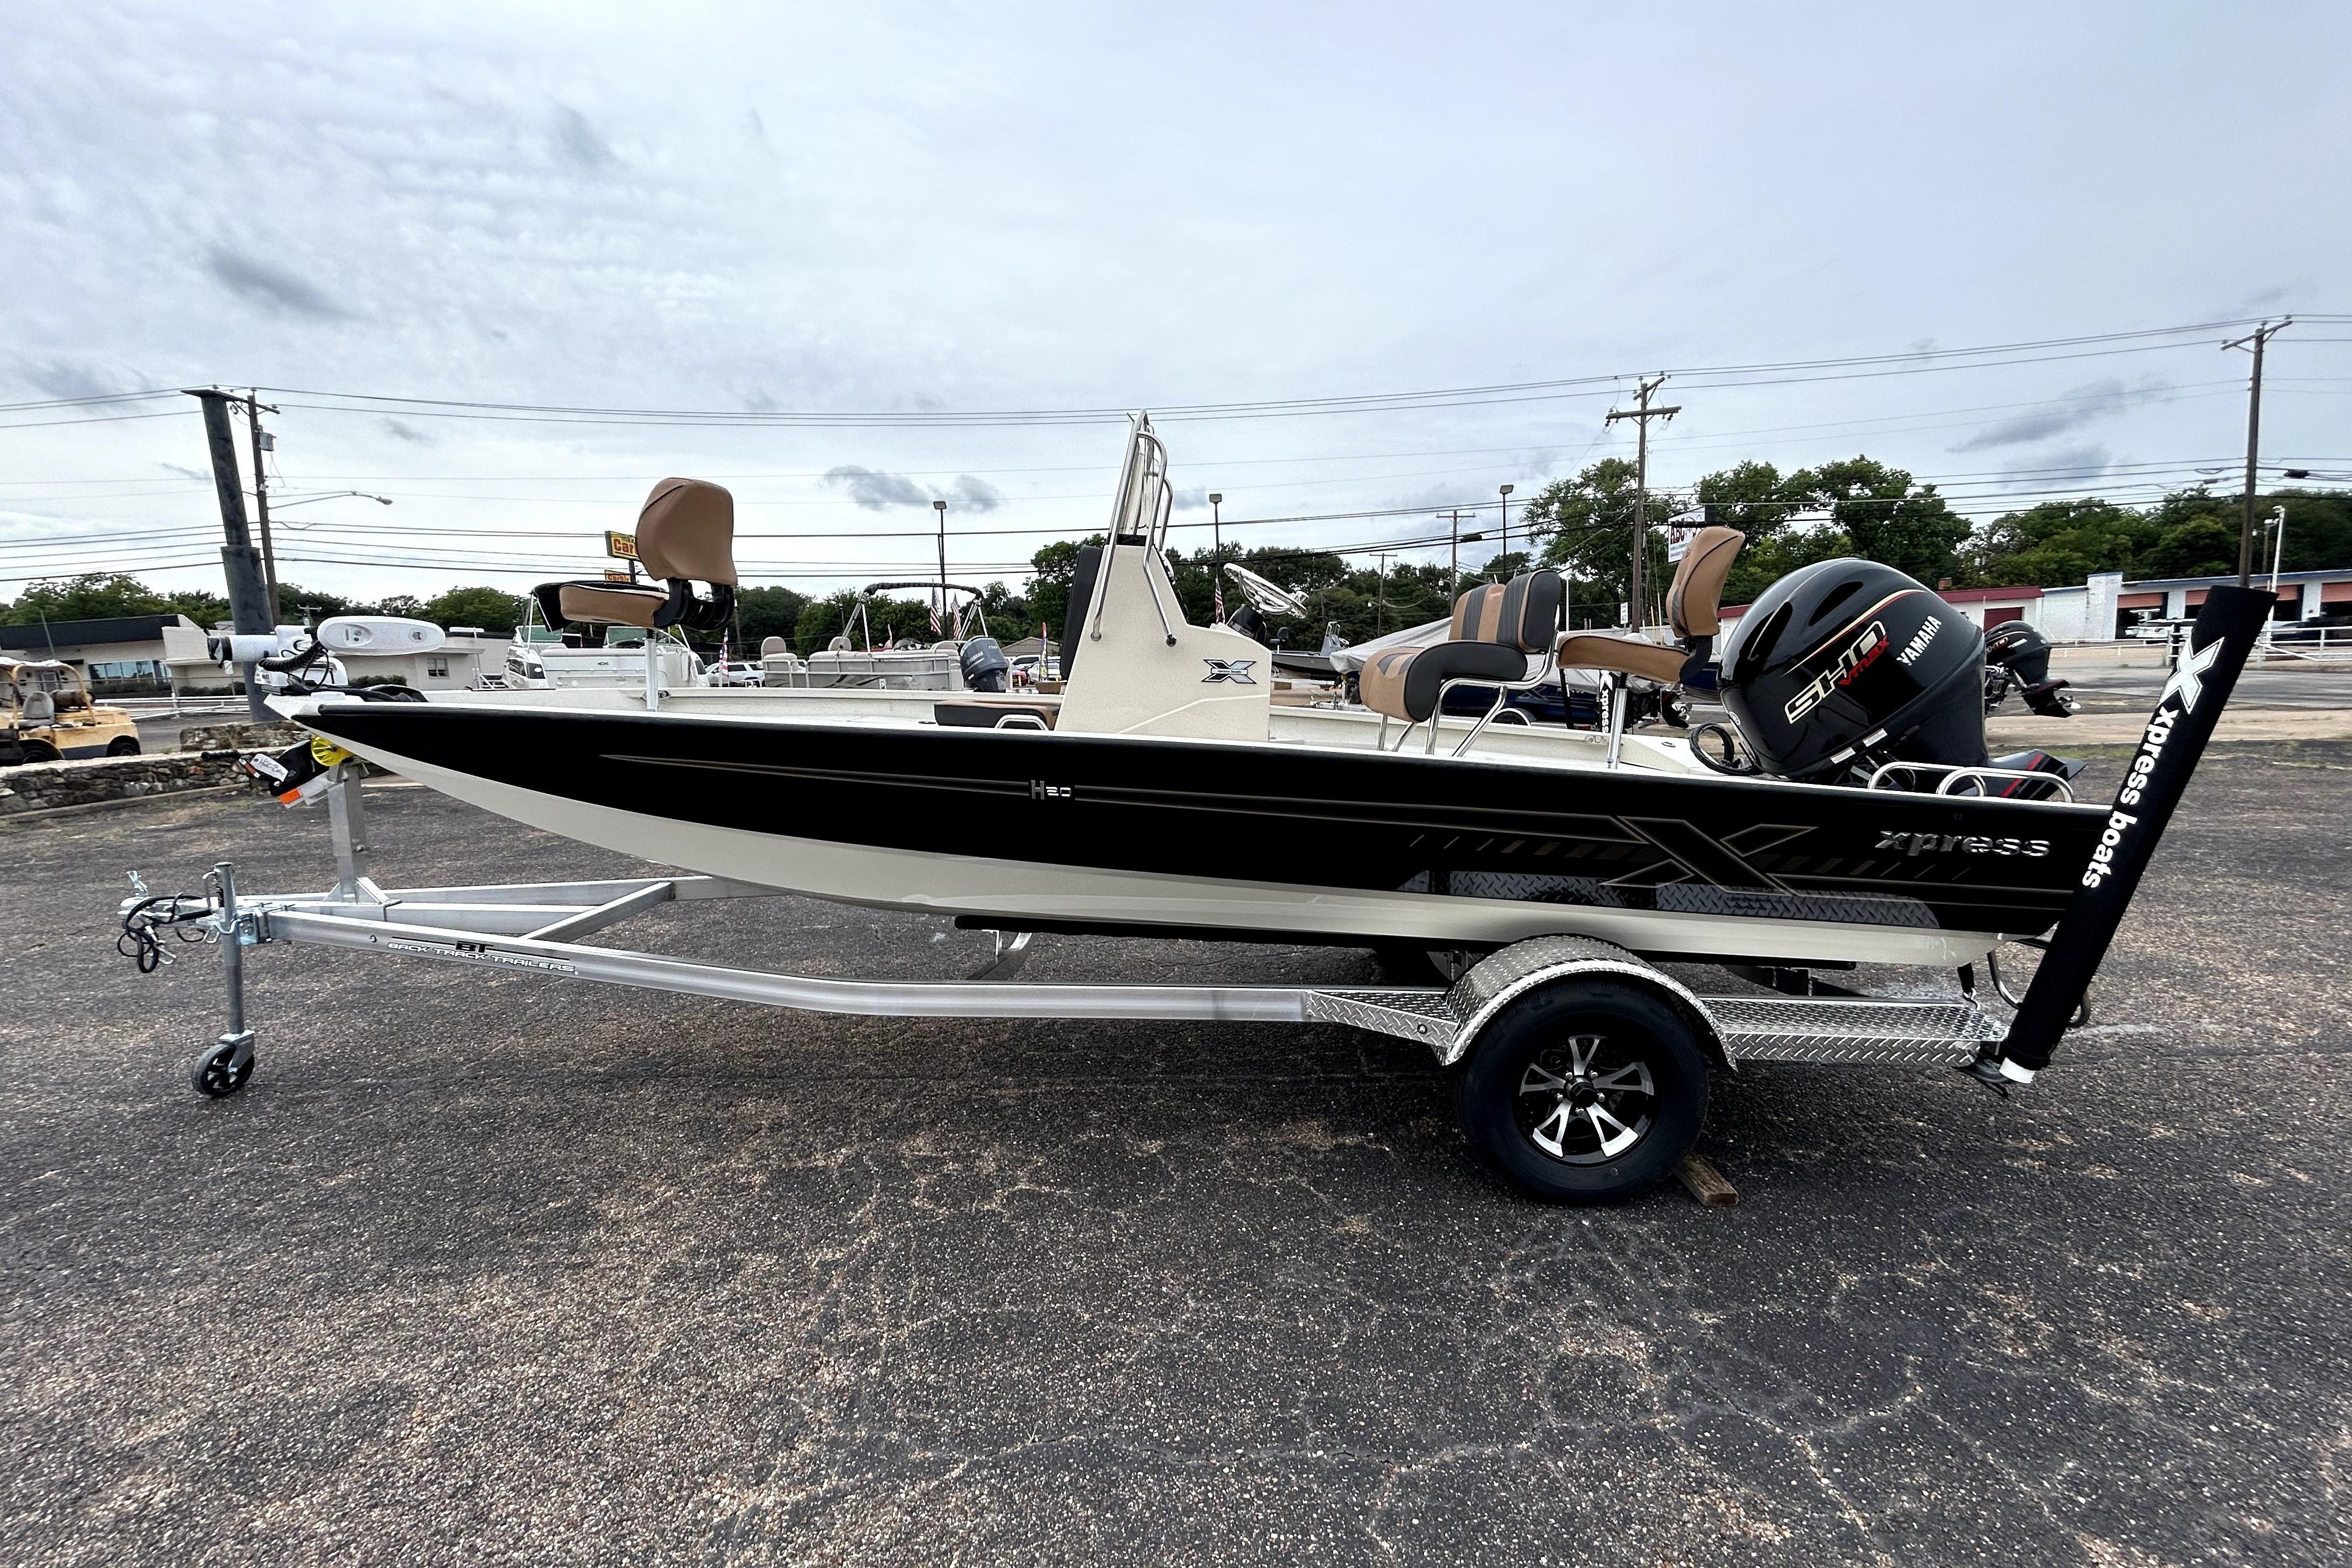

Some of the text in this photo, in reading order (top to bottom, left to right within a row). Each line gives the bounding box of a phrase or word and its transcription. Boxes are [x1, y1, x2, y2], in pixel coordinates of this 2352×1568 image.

[614, 538, 638, 554] Car
[1896, 615, 1942, 666] YAMAHA
[1784, 621, 1887, 724] SHO
[1600, 688, 1609, 733] xpress
[2125, 705, 2180, 806] xpress
[1874, 831, 2051, 857] xpress
[2081, 810, 2138, 888] boats
[387, 942, 575, 972] BACK TRACK TRAILERS
[456, 940, 494, 953] BT
